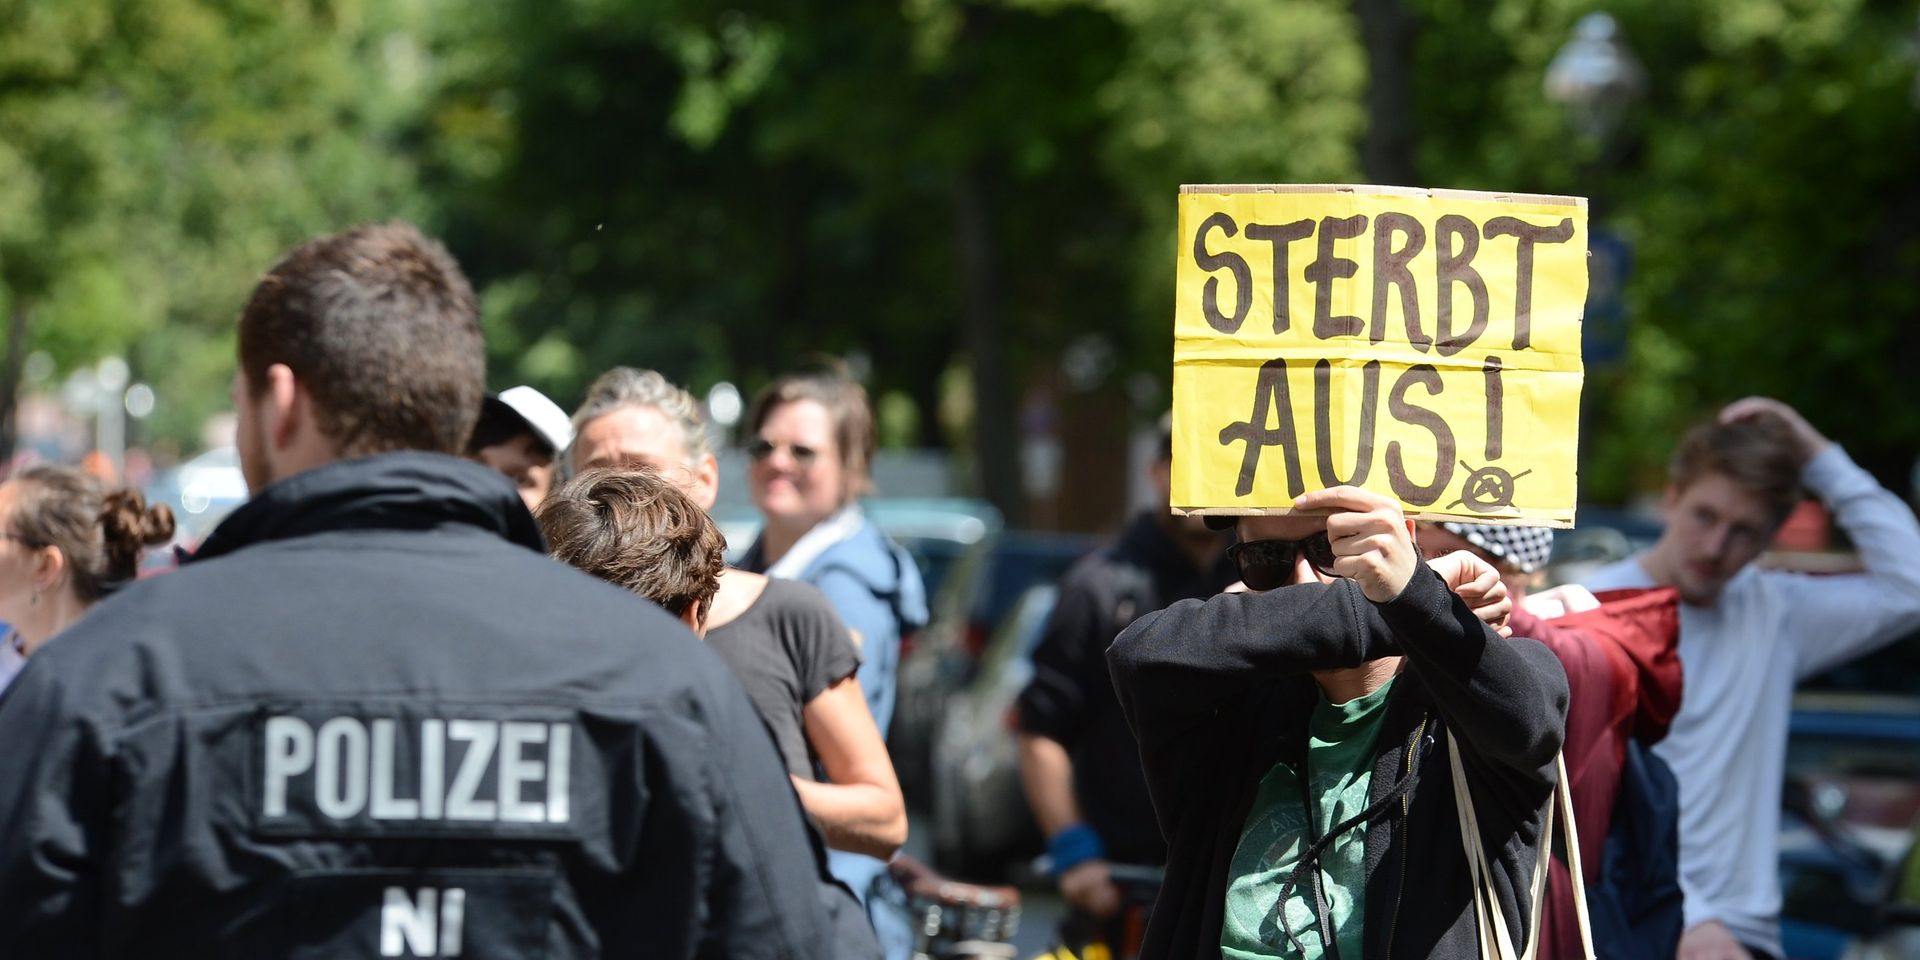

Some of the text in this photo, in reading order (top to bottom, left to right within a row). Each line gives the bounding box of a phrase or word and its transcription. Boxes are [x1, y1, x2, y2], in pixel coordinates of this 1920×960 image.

[1194, 212, 1575, 357] STERBT
[1219, 356, 1503, 507] AUS!
[263, 715, 572, 823] POLIZEI
[380, 886, 465, 957] NI
